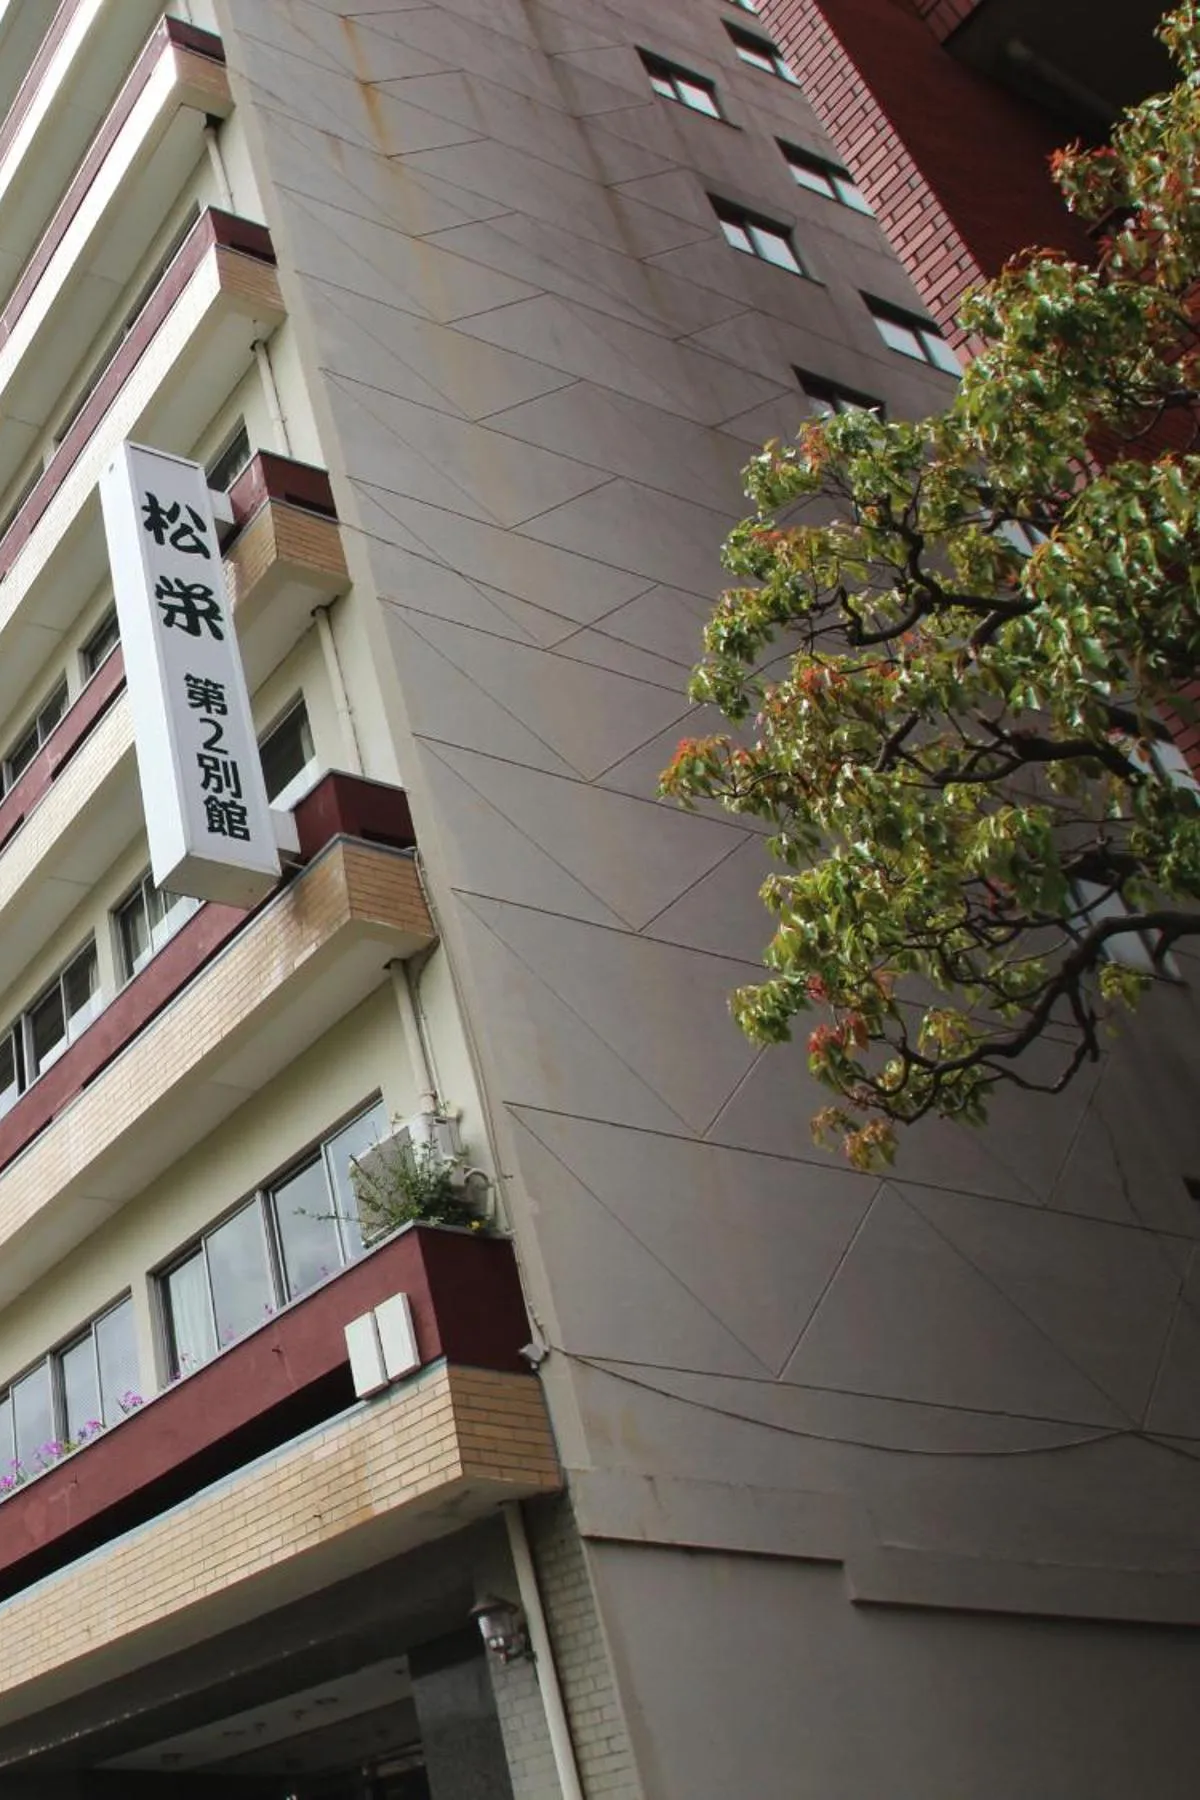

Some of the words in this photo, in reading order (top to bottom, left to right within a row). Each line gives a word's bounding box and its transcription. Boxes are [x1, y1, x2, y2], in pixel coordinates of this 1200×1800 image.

[140, 491, 225, 641] 松栄
[183, 672, 251, 842] 第2別館
